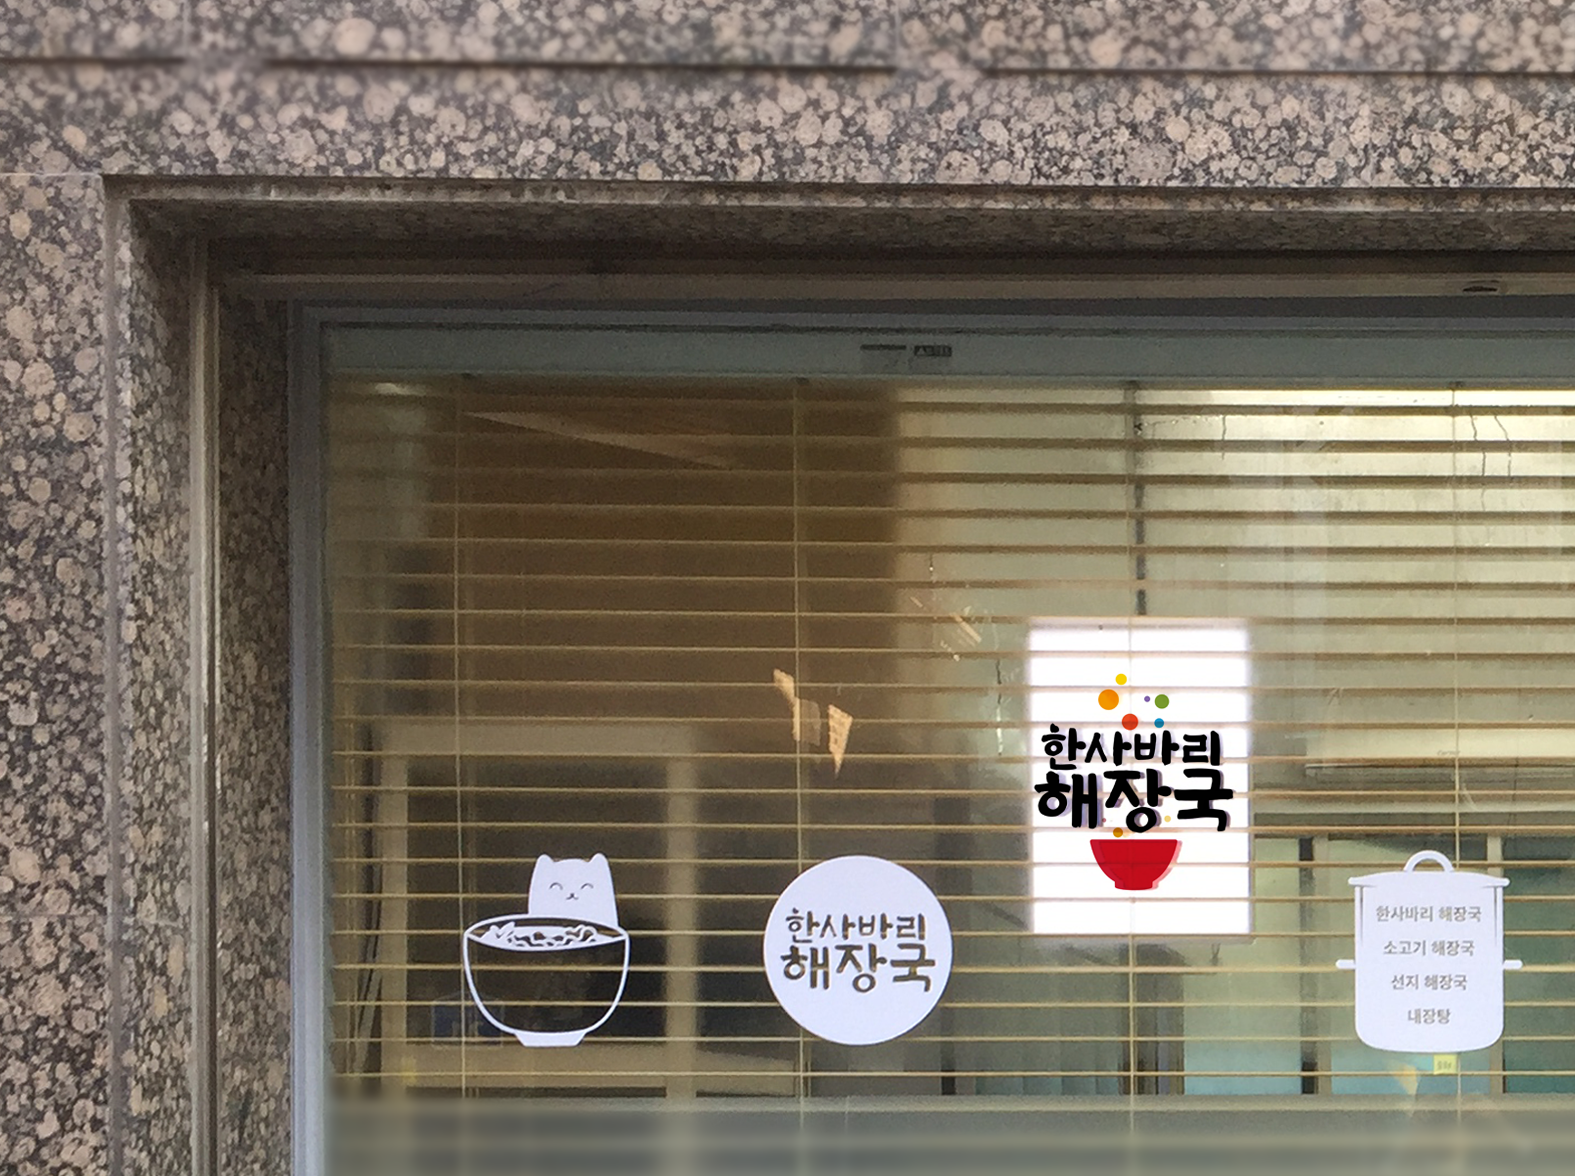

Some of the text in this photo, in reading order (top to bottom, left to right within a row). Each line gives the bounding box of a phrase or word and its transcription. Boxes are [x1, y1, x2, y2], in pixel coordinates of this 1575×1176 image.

[1041, 723, 1221, 771] 한사바리
[1034, 767, 1233, 832] 해장국
[786, 907, 926, 943] 한사바리
[1376, 906, 1481, 922] 한사바리 해장국
[1384, 940, 1474, 956] 소고기 해장국
[781, 943, 935, 993] 해장국
[1392, 974, 1467, 990] 선지 해장국
[1408, 1009, 1450, 1024] 내장탕
